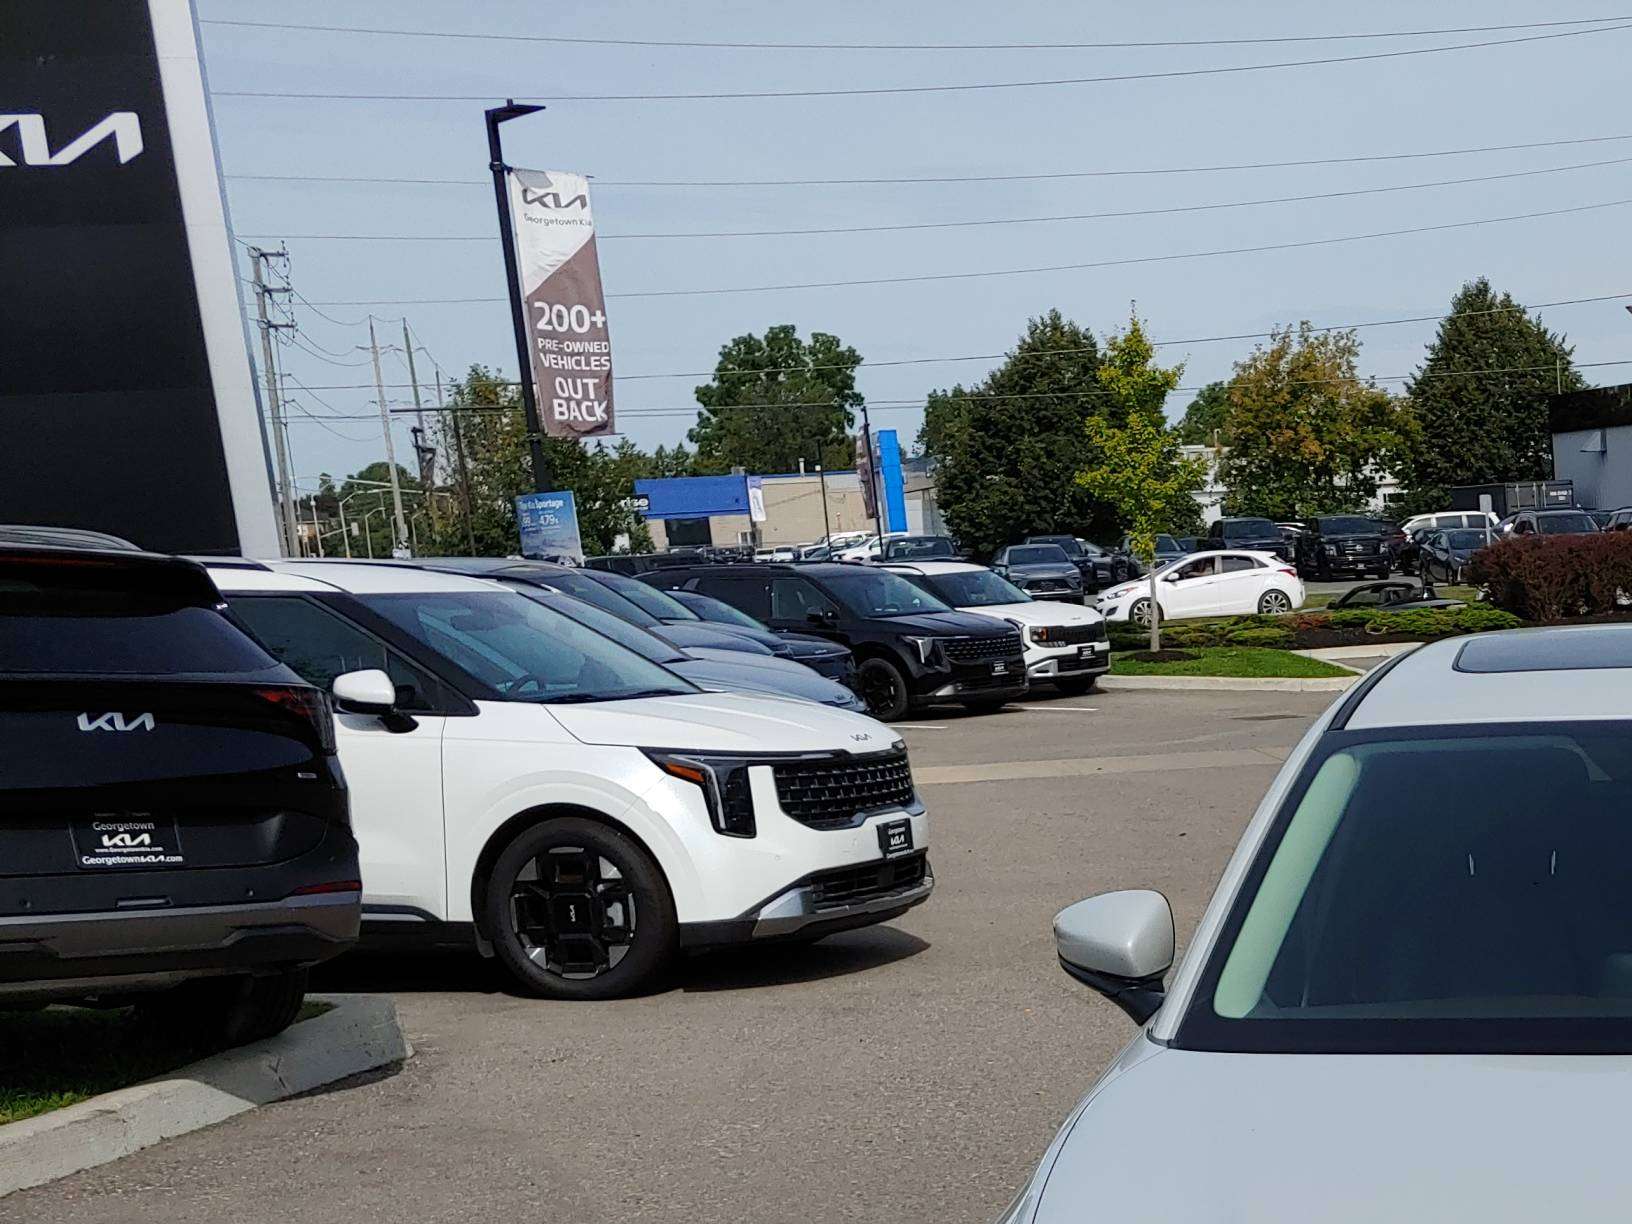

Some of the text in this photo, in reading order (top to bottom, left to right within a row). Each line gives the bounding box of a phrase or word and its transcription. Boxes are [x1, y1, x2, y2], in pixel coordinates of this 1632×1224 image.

[0, 112, 144, 167] IA
[521, 187, 588, 210] KIA
[533, 301, 606, 334] 200+
[537, 337, 610, 353] PRE-OWNED
[539, 352, 611, 371] VEHICLES
[554, 376, 600, 399] OUT
[552, 398, 609, 422] BACK
[77, 711, 156, 731] KIA
[92, 820, 155, 833] Georgetown
[101, 832, 152, 847] KIA
